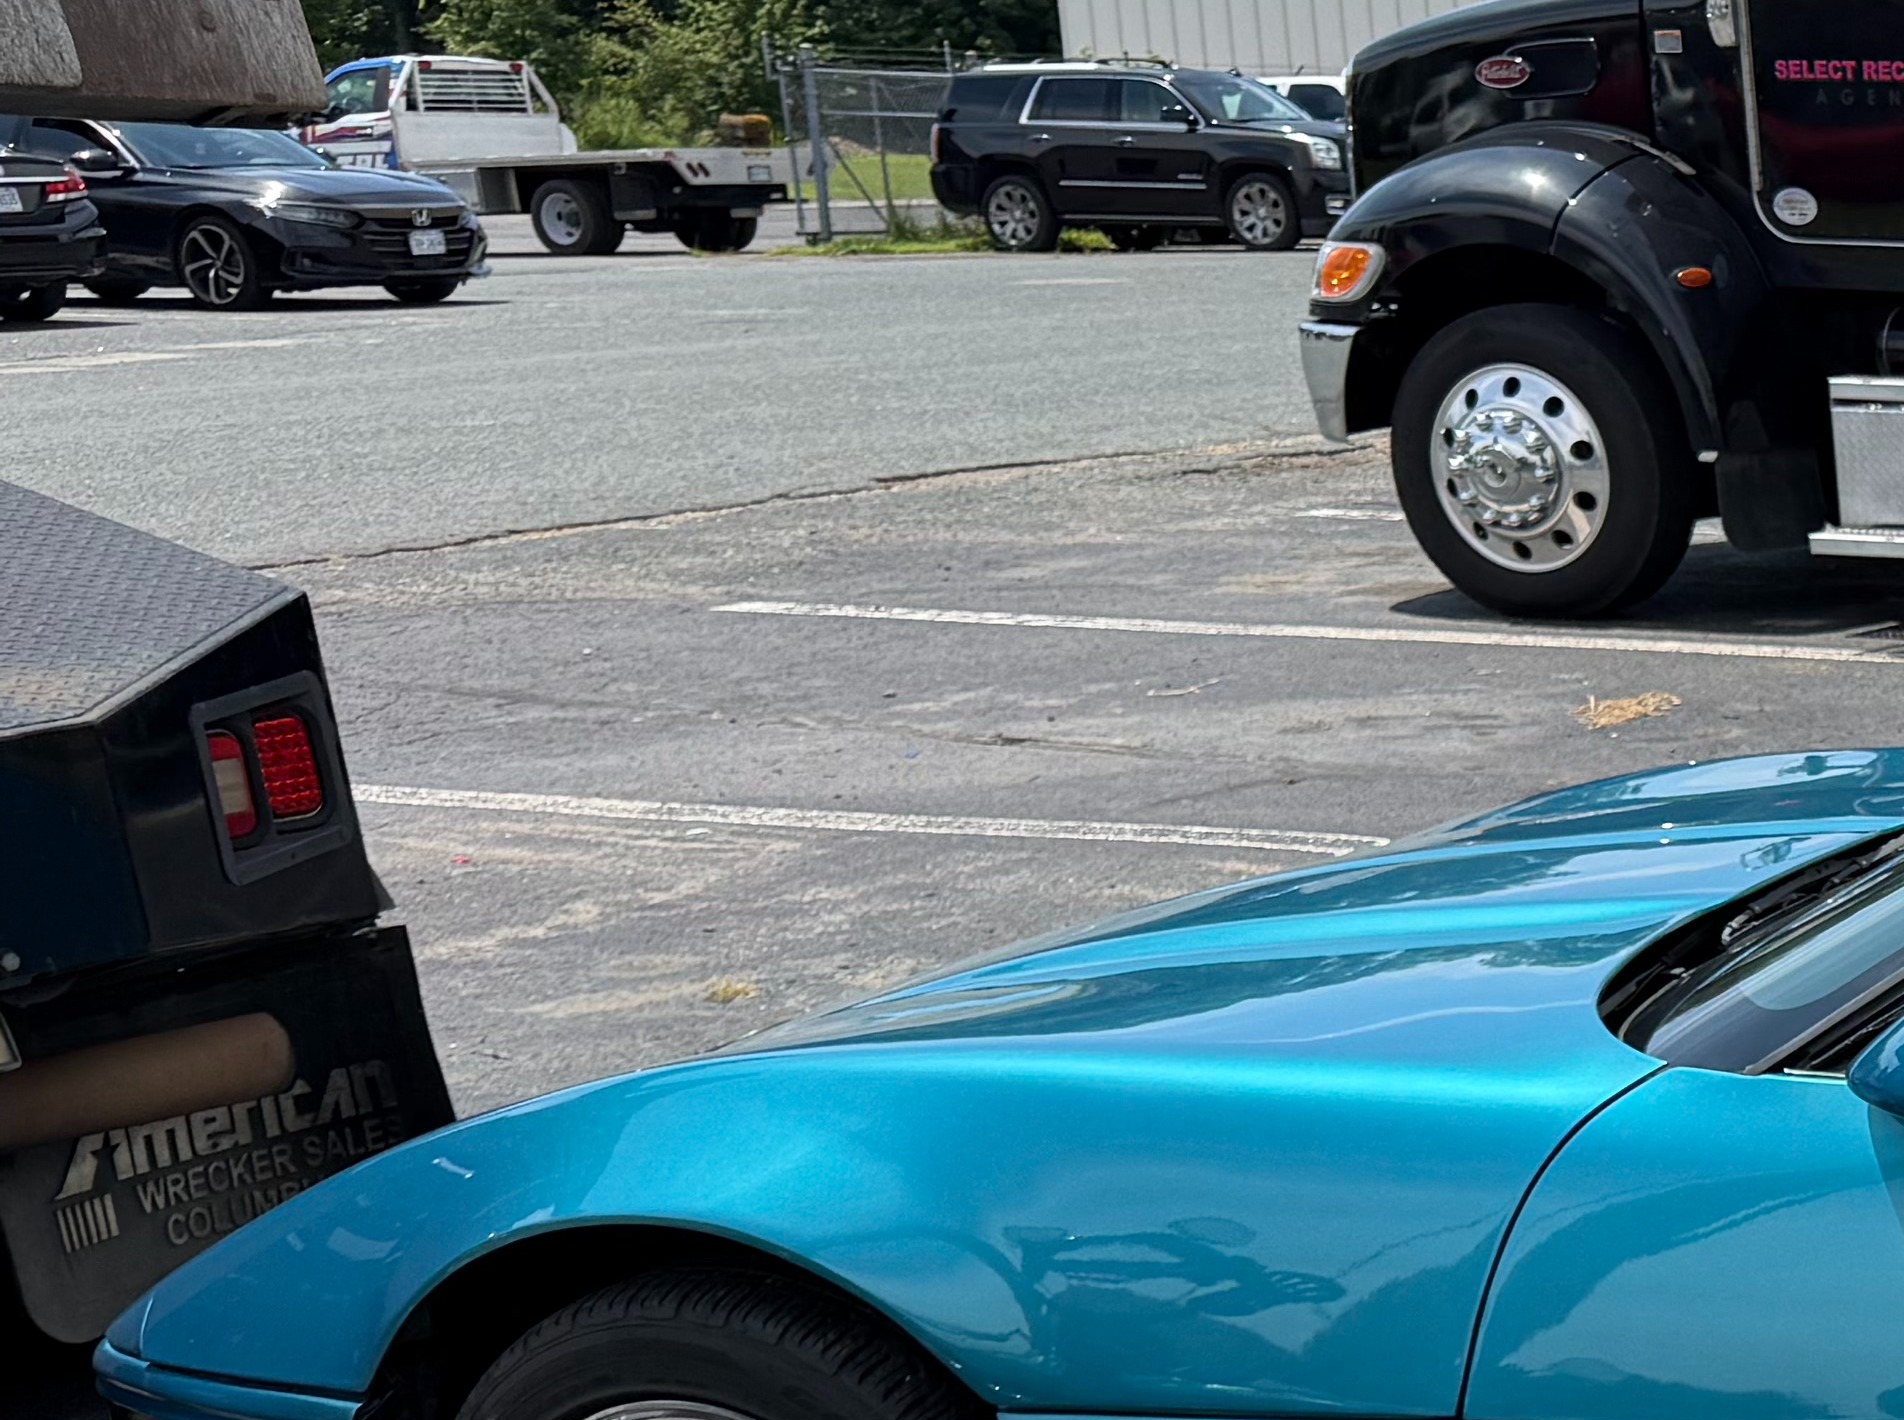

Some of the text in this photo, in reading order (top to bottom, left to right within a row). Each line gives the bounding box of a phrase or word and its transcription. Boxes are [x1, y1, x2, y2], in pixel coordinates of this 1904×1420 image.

[1774, 60, 1856, 81] SELECT
[136, 1112, 404, 1214] WRECKER SALES
[166, 1174, 322, 1246] COLUMB
